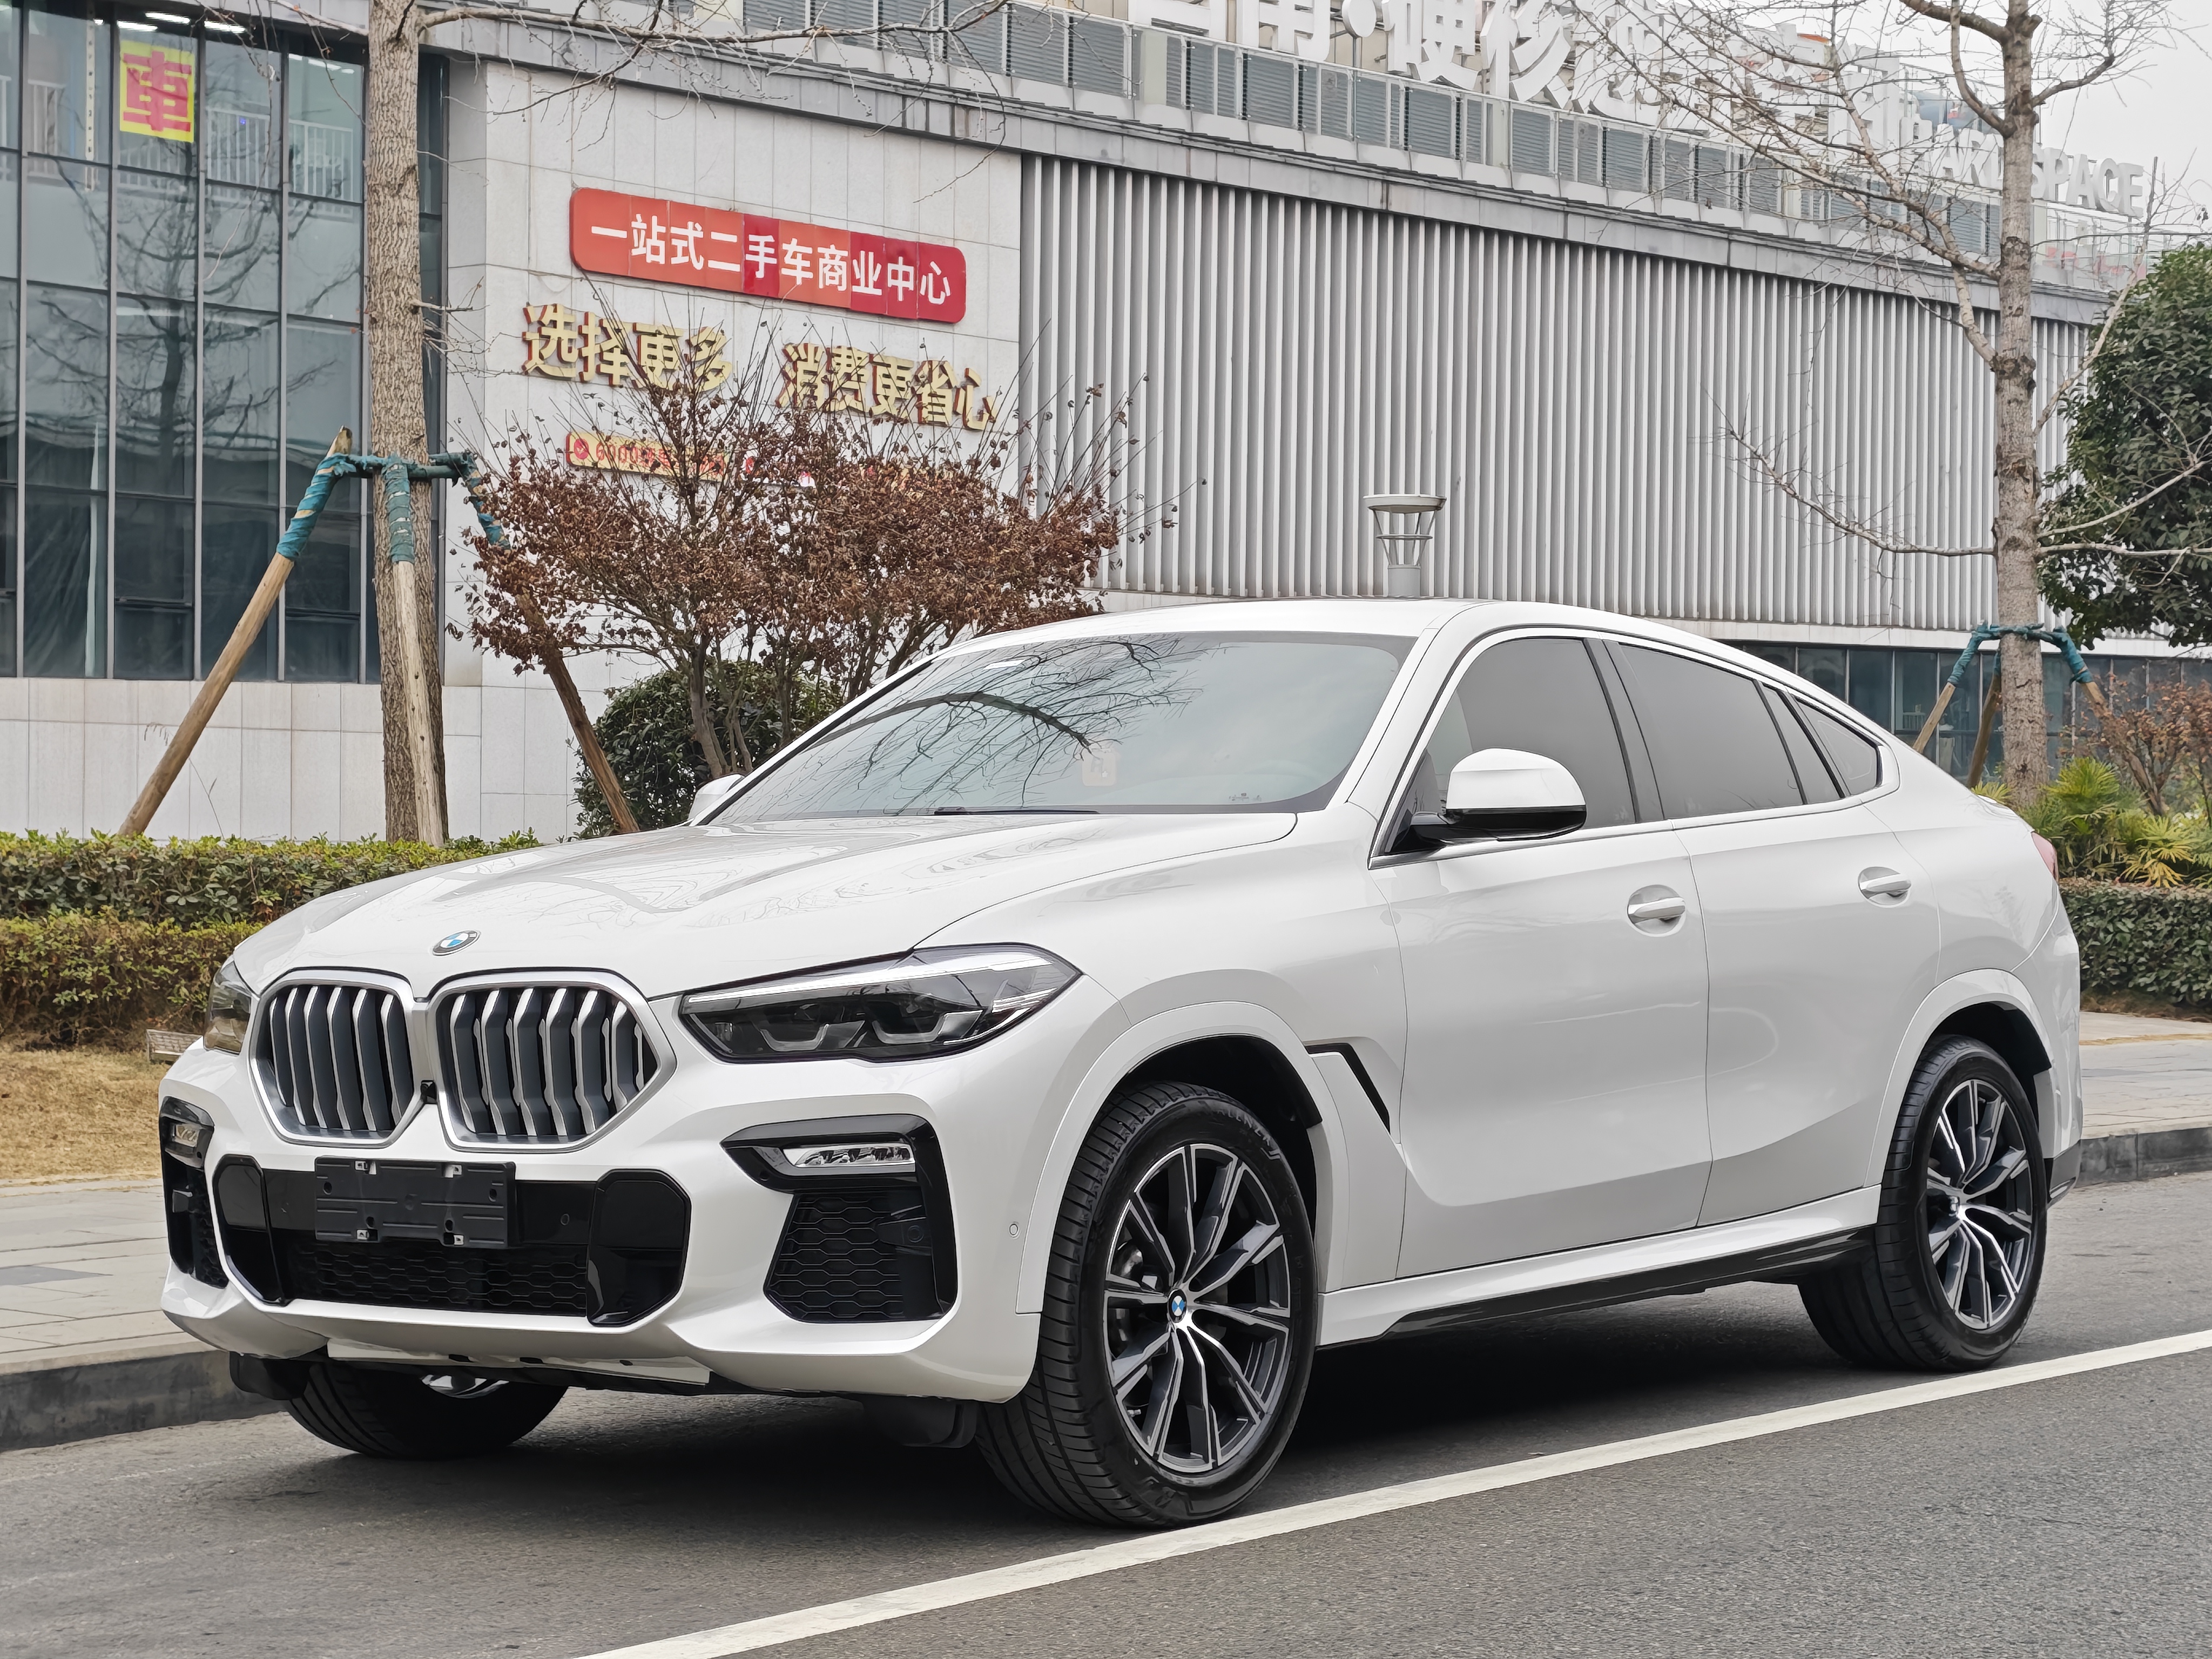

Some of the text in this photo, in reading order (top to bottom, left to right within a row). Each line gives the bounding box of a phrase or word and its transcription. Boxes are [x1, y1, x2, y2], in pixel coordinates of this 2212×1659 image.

[123, 50, 192, 132] 車
[591, 213, 950, 306] 一站式二手车商业中心
[522, 304, 999, 431] 选择更多 消费更省心
